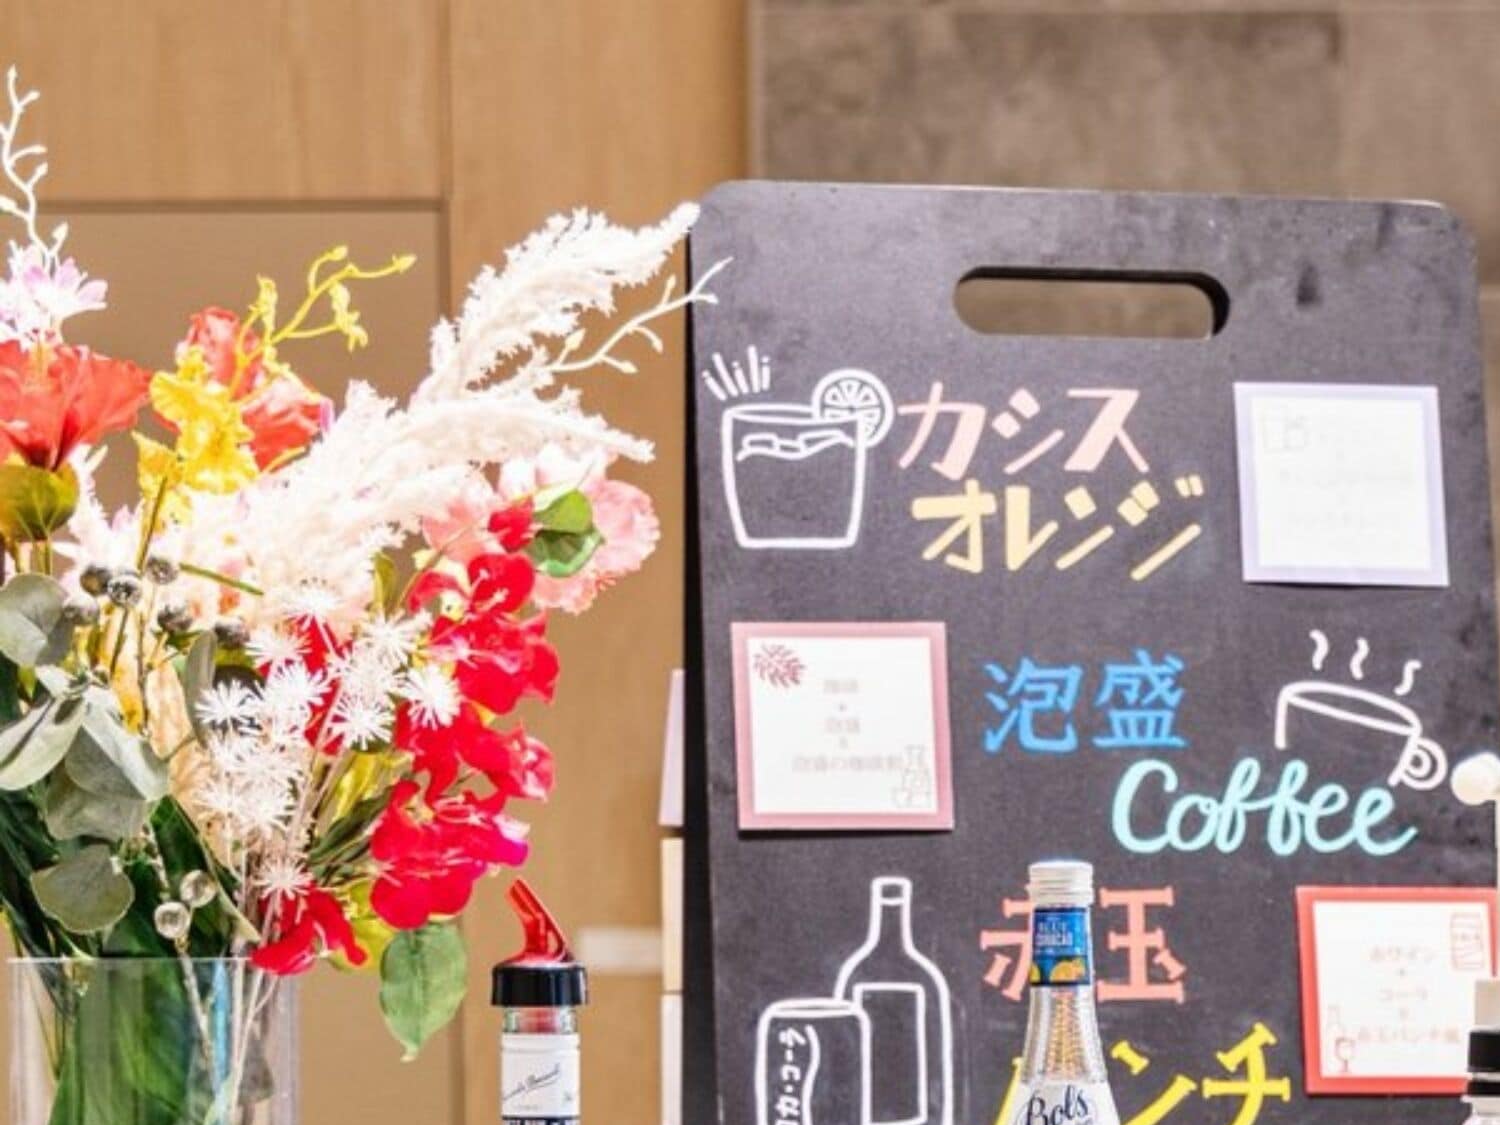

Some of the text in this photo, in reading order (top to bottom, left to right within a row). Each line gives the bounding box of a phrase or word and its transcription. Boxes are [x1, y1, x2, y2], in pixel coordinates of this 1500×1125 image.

[898, 382, 1149, 479] カシス
[912, 476, 1205, 580] オレンジ
[982, 648, 1187, 753] 泡盛
[1111, 757, 1419, 858] Coffee
